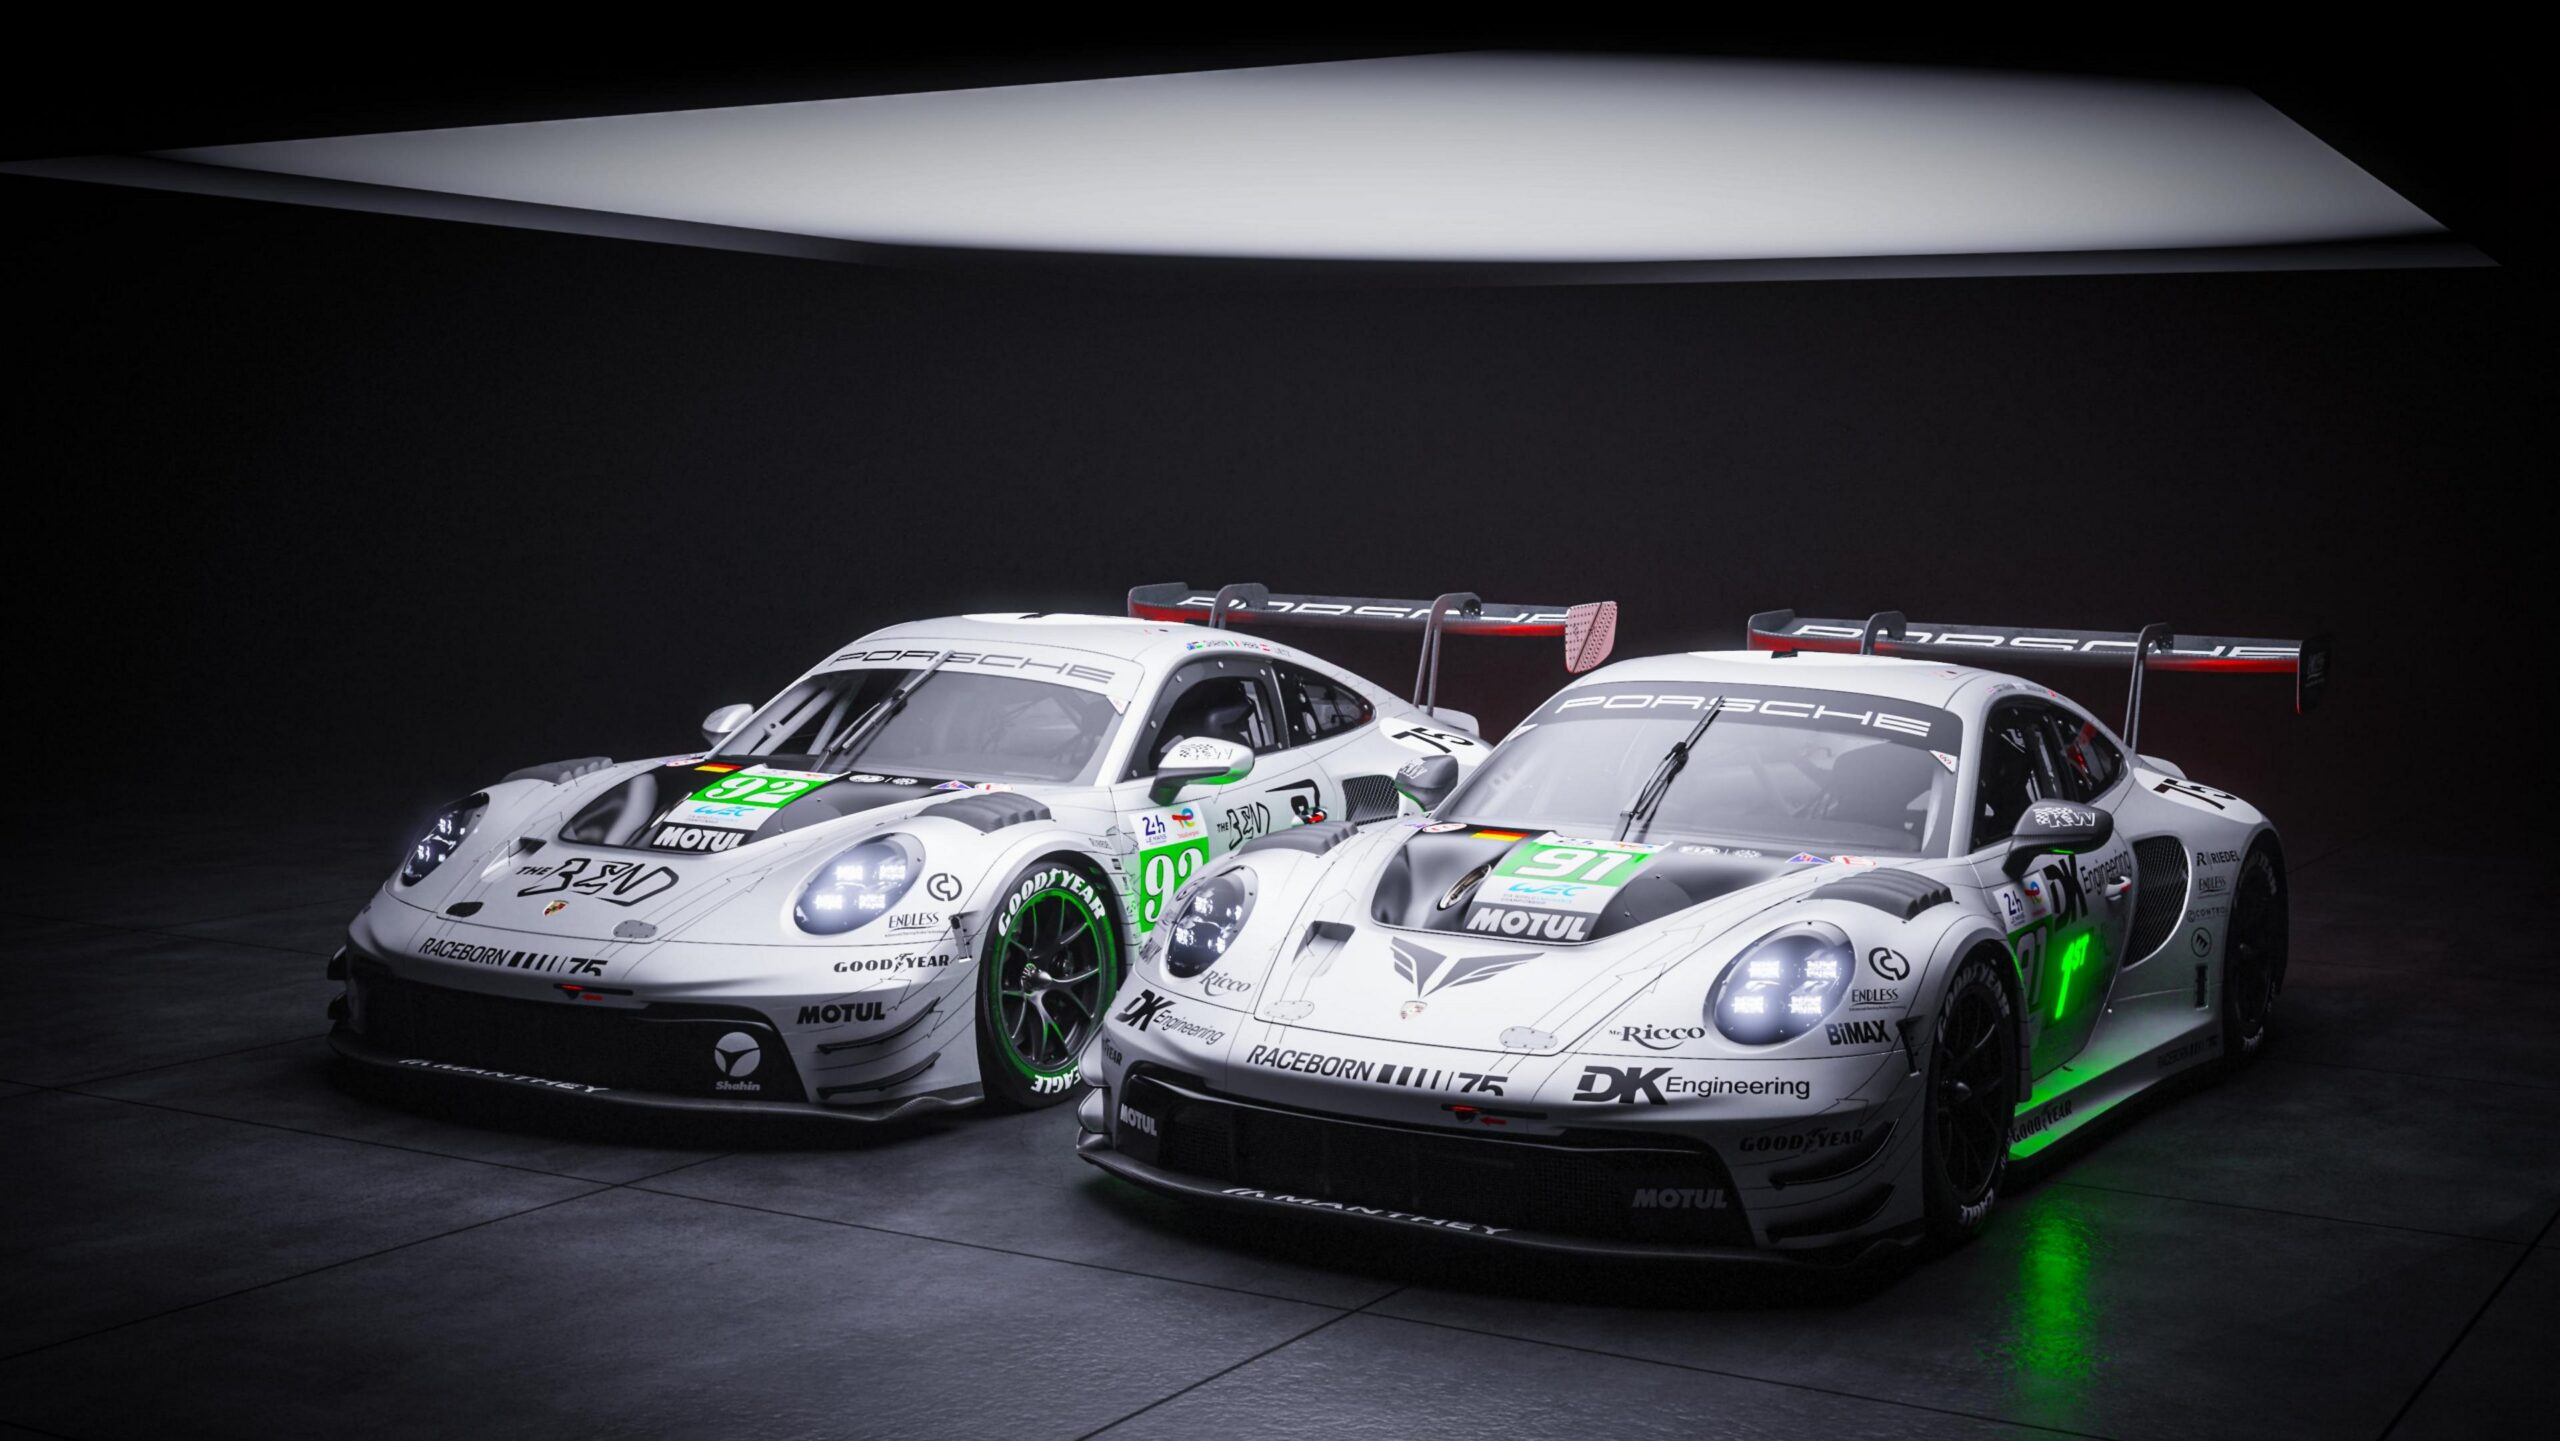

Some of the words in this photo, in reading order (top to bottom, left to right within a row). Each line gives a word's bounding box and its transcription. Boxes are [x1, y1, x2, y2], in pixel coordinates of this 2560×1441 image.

[829, 651, 1116, 684] PORSCHE
[1556, 694, 1931, 738] PORSCHE
[1391, 727, 1475, 753] 75
[704, 777, 810, 805] 92
[653, 826, 746, 852] MOTUL
[1216, 822, 1229, 832] THE
[515, 866, 549, 876] THE
[1514, 847, 1633, 882] 91
[2211, 850, 2240, 865] RIEDEL
[2080, 849, 2132, 896] Engineering
[999, 868, 1107, 936] GOODYEAR
[888, 912, 940, 929] ENDLESS
[1466, 906, 1587, 941] MOTUL
[418, 938, 509, 966] RACEBORN
[568, 957, 608, 977] 75
[833, 952, 950, 973] GOODYEAR
[1198, 970, 1252, 997] Ricco
[1851, 988, 1899, 1003] ENDLESS
[796, 1001, 886, 1025] MOTUL
[1114, 989, 1173, 1031] DK
[1153, 1009, 1226, 1046] Engineering
[1621, 1023, 1706, 1051] Ricco
[1825, 1019, 1892, 1046] BiMAX
[1246, 1044, 1376, 1082] RACEBORN
[1457, 1072, 1510, 1096] 75
[715, 1080, 761, 1091] Shahin
[1572, 1065, 1674, 1105] DK
[1665, 1076, 1811, 1099] Engineering
[1119, 1103, 1158, 1137] MOTUL
[1739, 1129, 1864, 1153] GOODYEAR
[1631, 1188, 1728, 1209] MOTUL
[1273, 1194, 1513, 1236] MANTHEY
